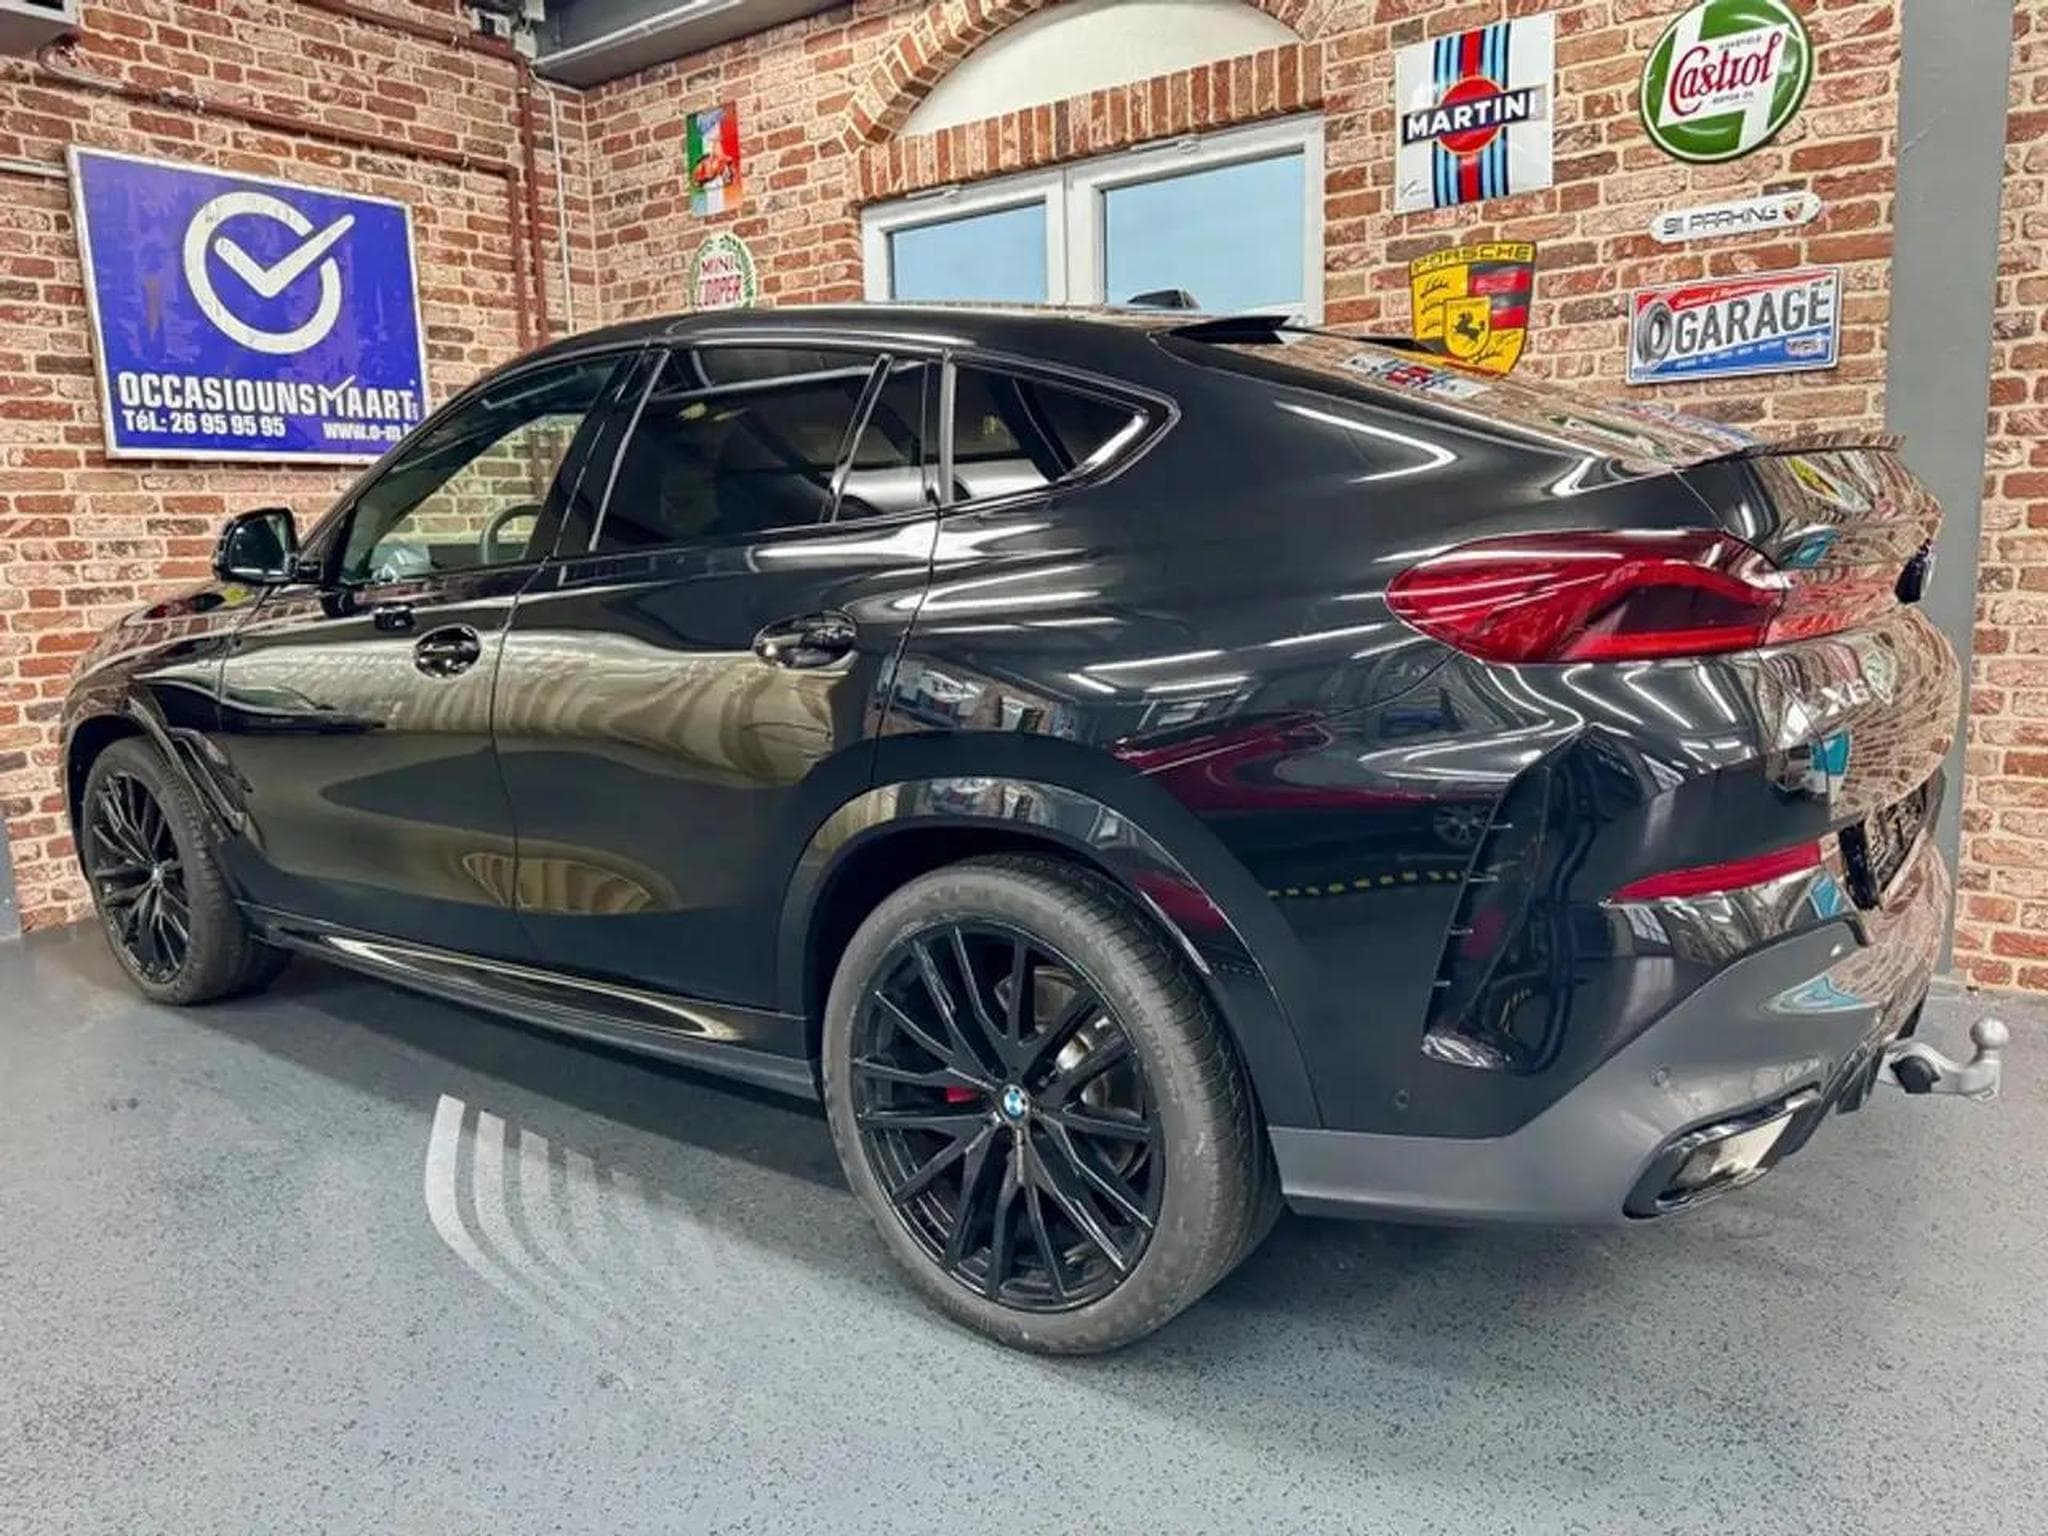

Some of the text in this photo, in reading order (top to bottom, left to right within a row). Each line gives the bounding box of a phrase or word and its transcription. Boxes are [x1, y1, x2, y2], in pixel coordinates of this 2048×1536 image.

[1669, 31, 1782, 117] Castrol
[1406, 90, 1536, 140] MARTINI
[1690, 205, 1778, 230] PARKING
[701, 254, 741, 274] MINI
[1413, 245, 1530, 271] PORSCHE
[1674, 279, 1832, 354] GARAGE
[118, 371, 414, 421] OCCASIOUNSMAART
[170, 412, 197, 434] 26
[202, 413, 228, 435] 95
[231, 414, 257, 437] 95
[260, 416, 286, 438] 95
